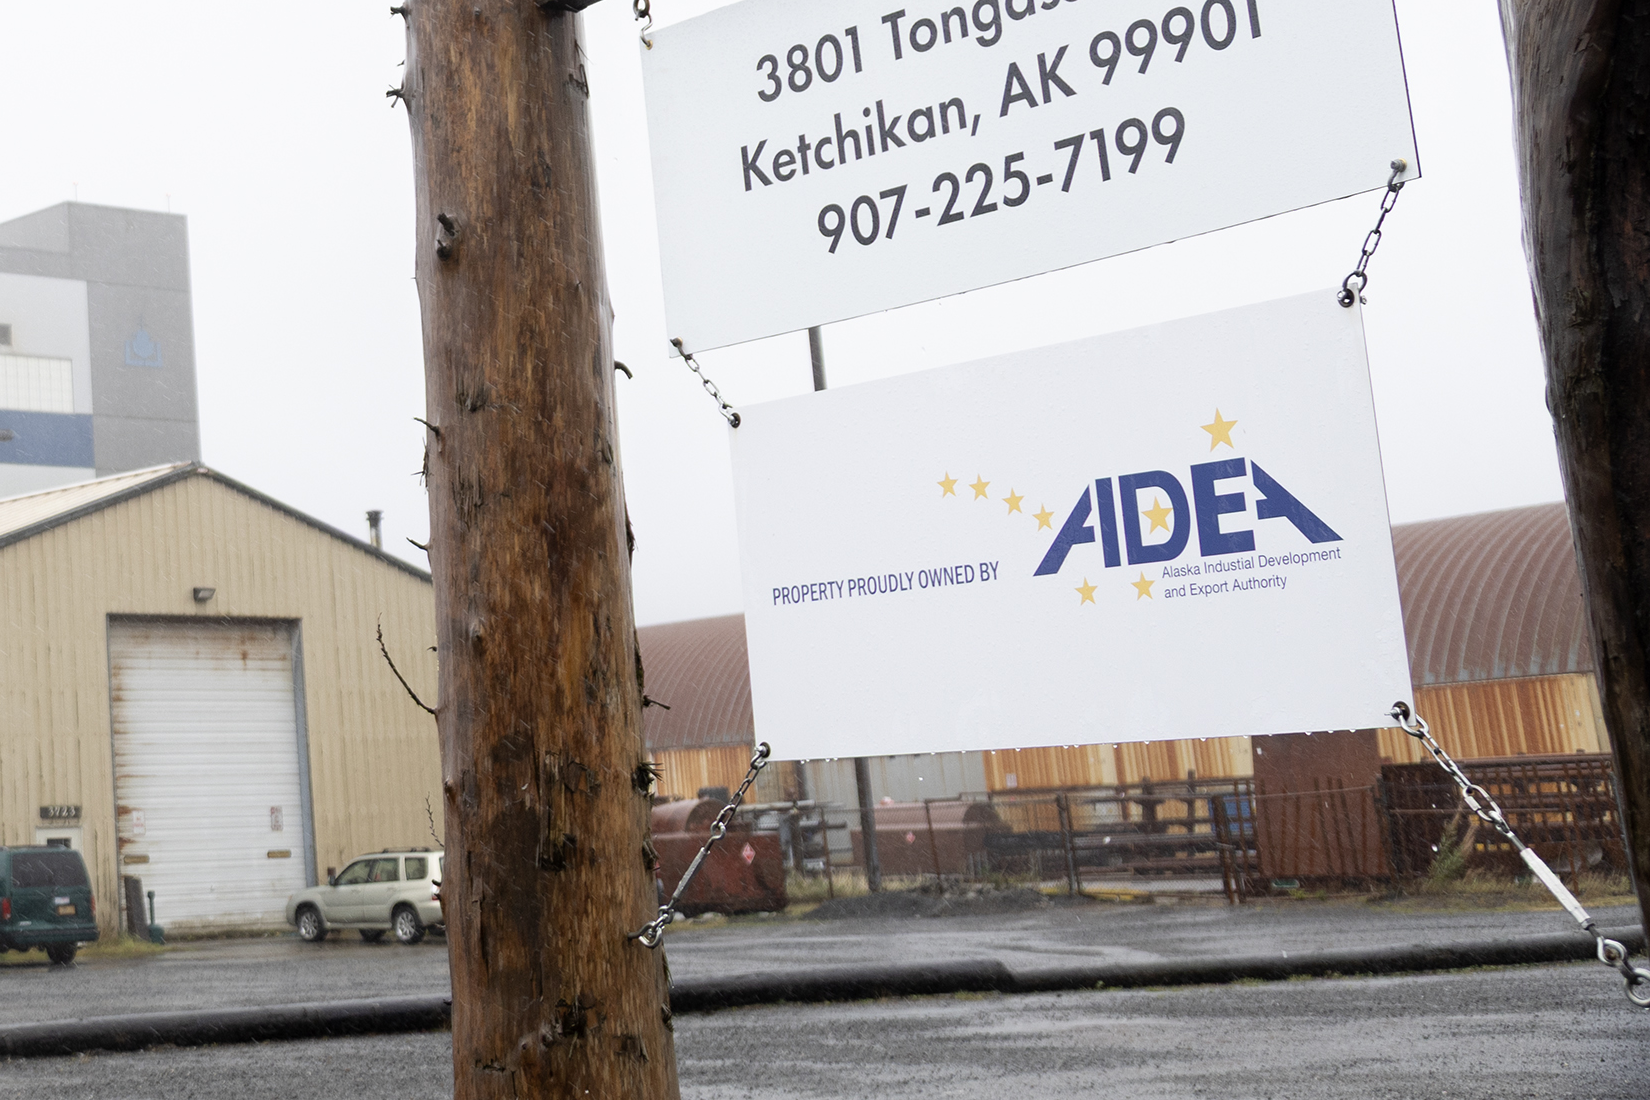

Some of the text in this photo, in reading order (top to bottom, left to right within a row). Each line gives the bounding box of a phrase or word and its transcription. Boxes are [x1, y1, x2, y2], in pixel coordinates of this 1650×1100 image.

[755, 24, 864, 104] 3801
[739, 96, 982, 193] Ketchikan,
[998, 43, 1078, 119] AK
[816, 105, 1186, 256] 907-225-7199
[1032, 456, 1345, 578] AIDEA
[771, 560, 1000, 607] PROPERTY PROUDLY OWNED BY
[1161, 546, 1343, 579] Alaska Industial Development
[1163, 574, 1288, 599] and Export Authority
